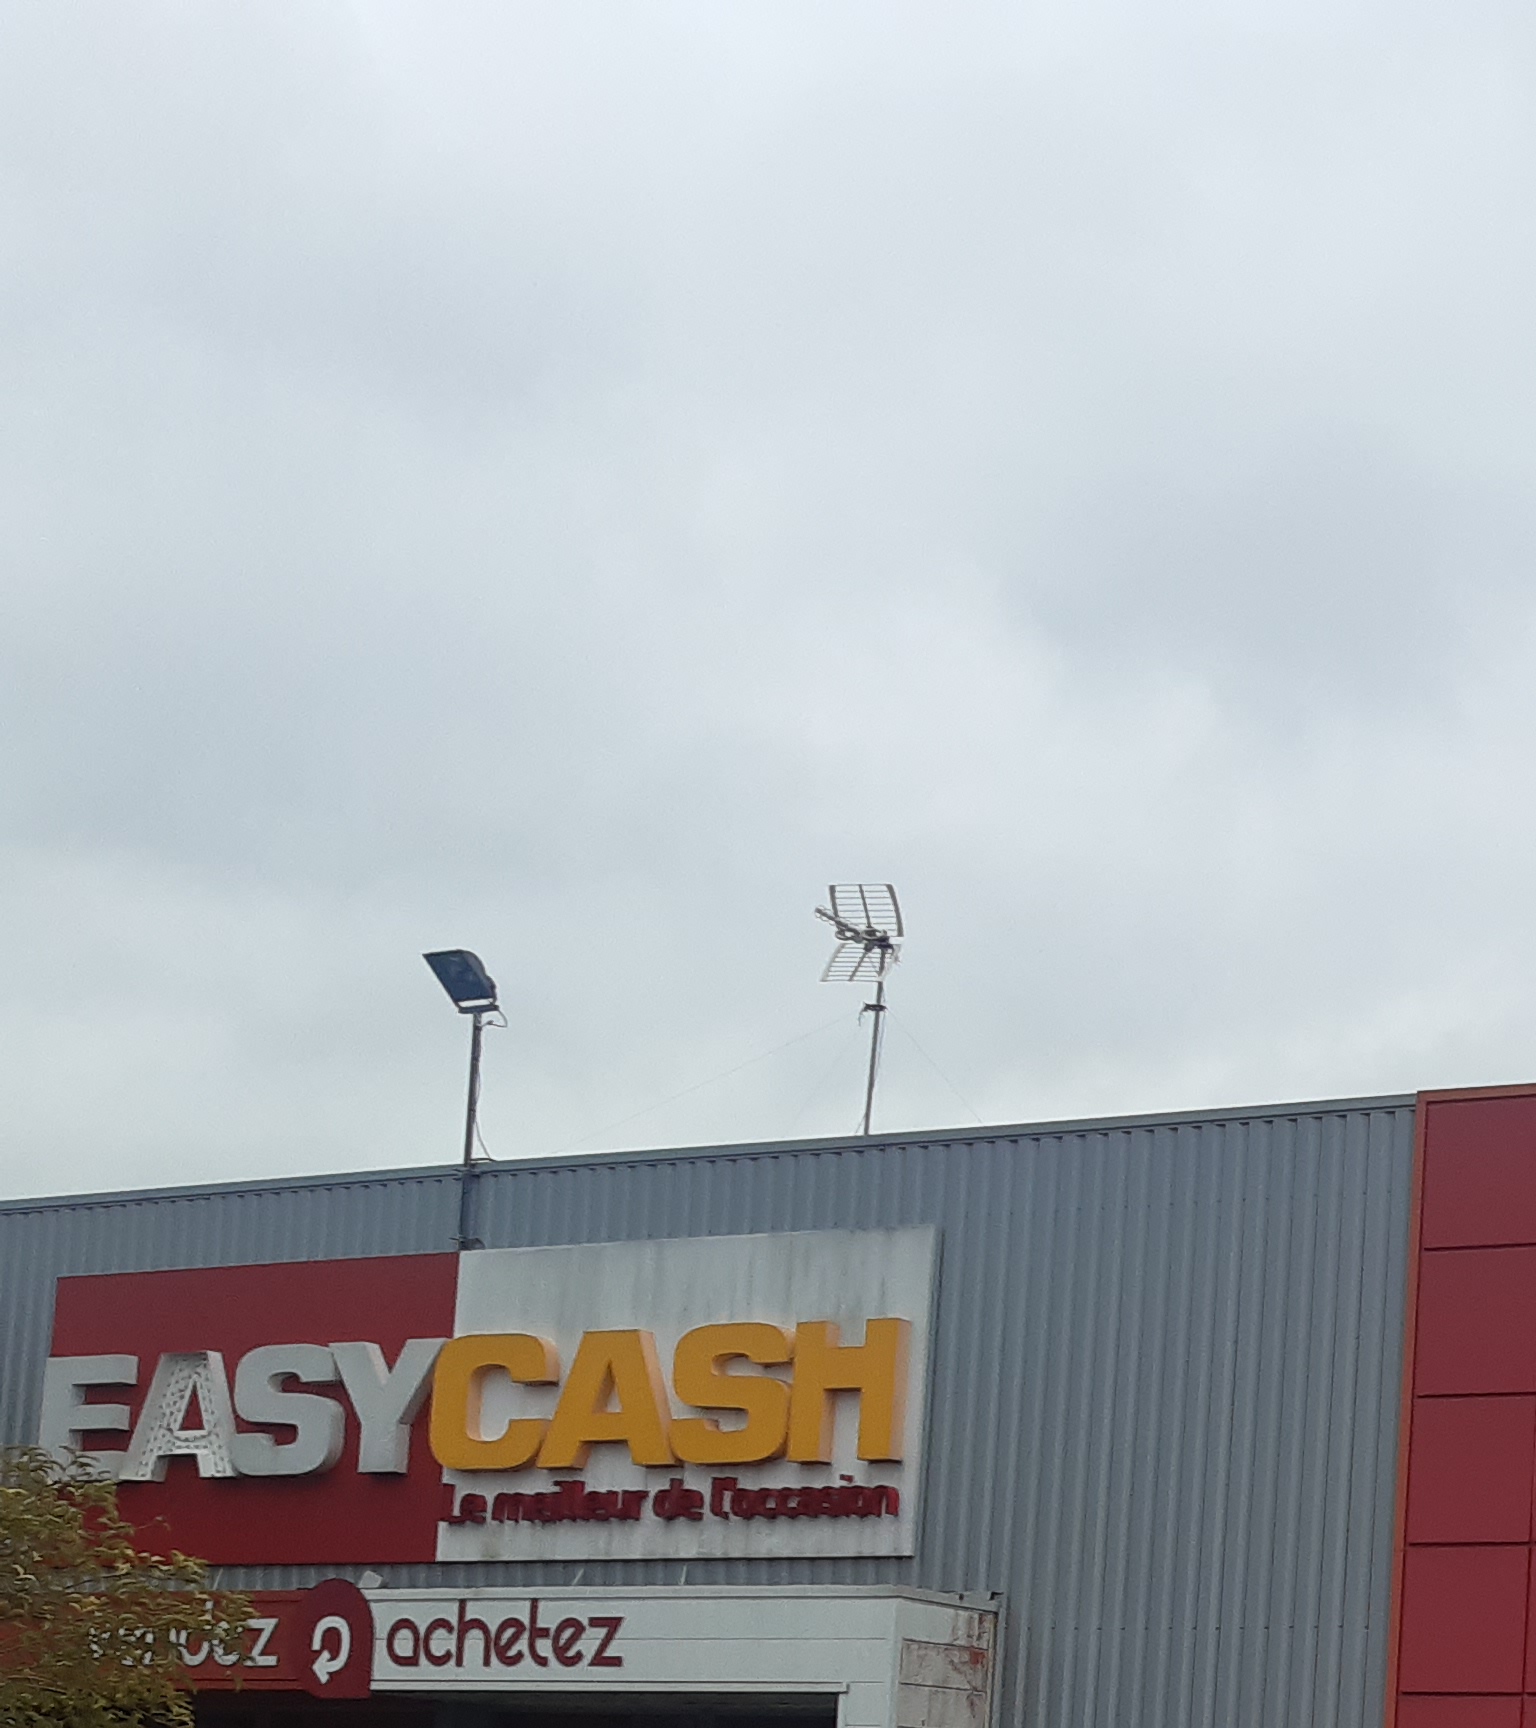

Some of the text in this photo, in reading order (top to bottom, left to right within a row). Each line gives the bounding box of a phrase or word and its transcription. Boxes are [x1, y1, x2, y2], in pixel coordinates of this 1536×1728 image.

[440, 1483, 487, 1524] Le
[492, 1480, 649, 1522] meilleur
[653, 1478, 704, 1520] de
[387, 1600, 625, 1670] achetez
